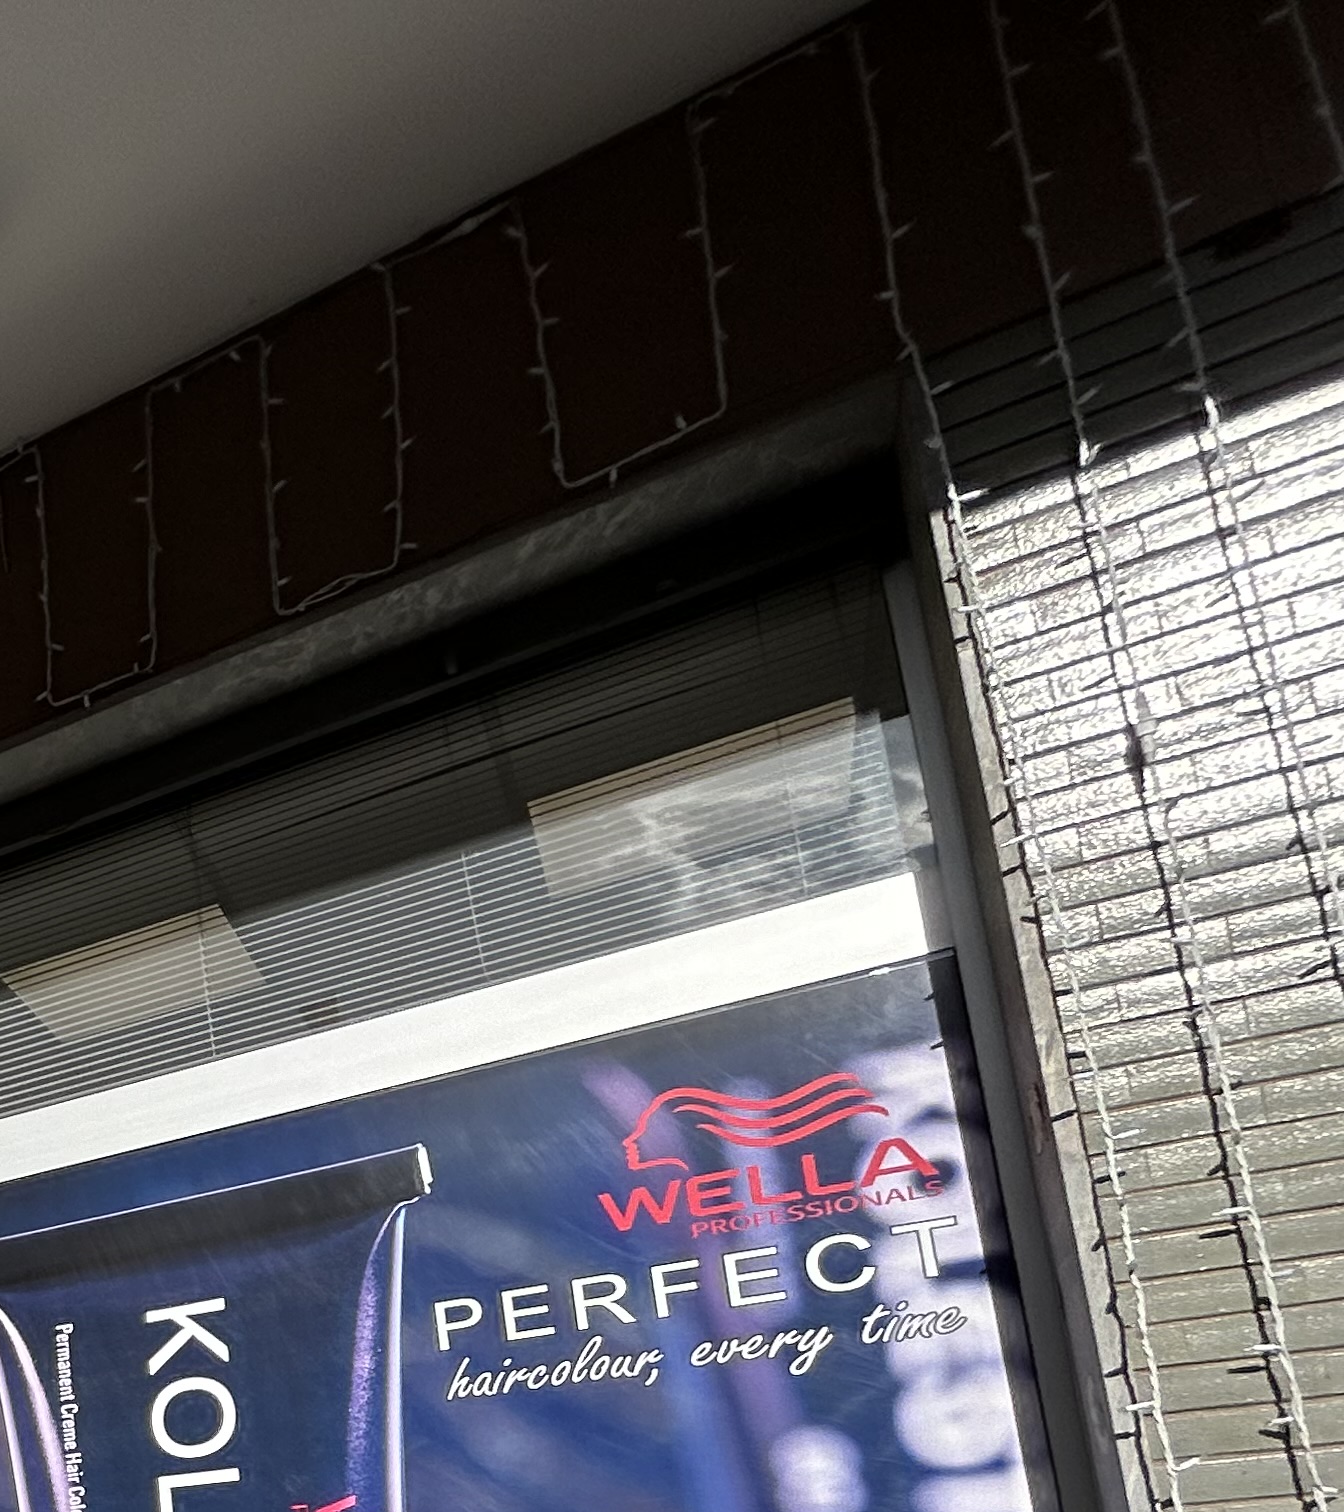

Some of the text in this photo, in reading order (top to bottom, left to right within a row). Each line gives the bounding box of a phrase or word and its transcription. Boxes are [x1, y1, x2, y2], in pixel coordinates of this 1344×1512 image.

[598, 1138, 939, 1231] WELLA
[691, 1179, 944, 1238] PROFESSIONALS
[433, 1216, 957, 1351] PERFECT
[54, 1323, 73, 1402] Permanent
[447, 1301, 967, 1401] haircolour, every time
[61, 1405, 79, 1451] Creme
[64, 1453, 82, 1480] Hair
